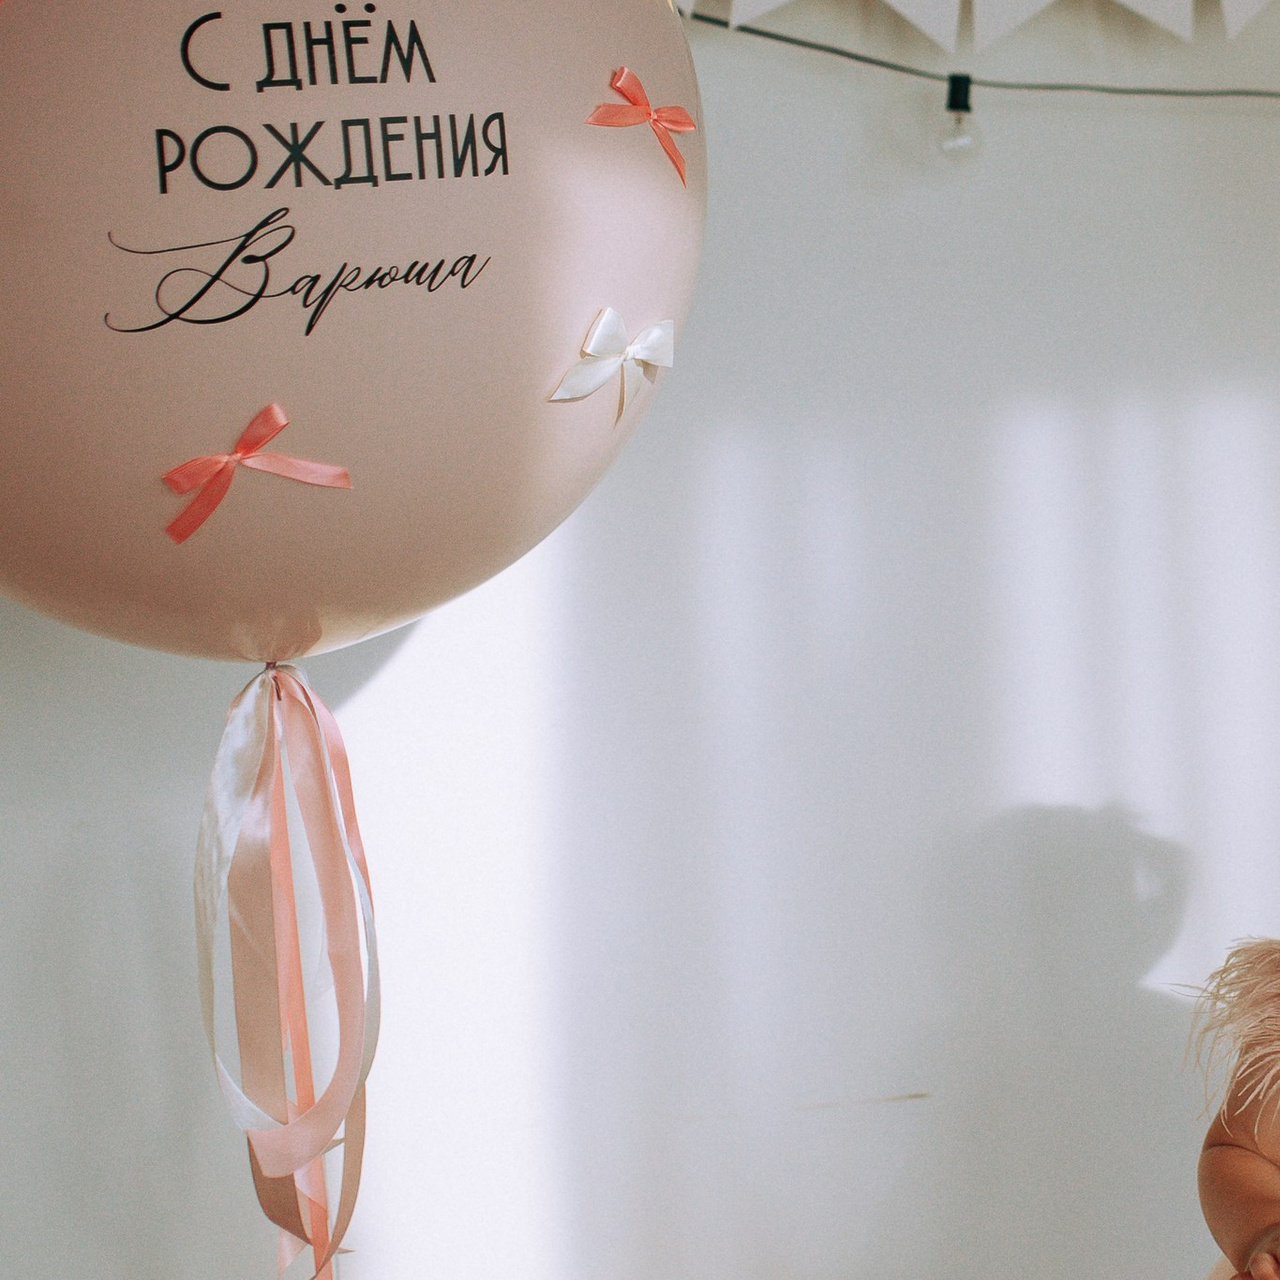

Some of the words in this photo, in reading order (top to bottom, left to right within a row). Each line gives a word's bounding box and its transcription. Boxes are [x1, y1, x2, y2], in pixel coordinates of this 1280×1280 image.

[180, 11, 231, 91] С
[255, 3, 436, 93] ДНЁМ
[155, 112, 509, 194] РОЖДЕНИЯ
[104, 207, 491, 336] Варюша
